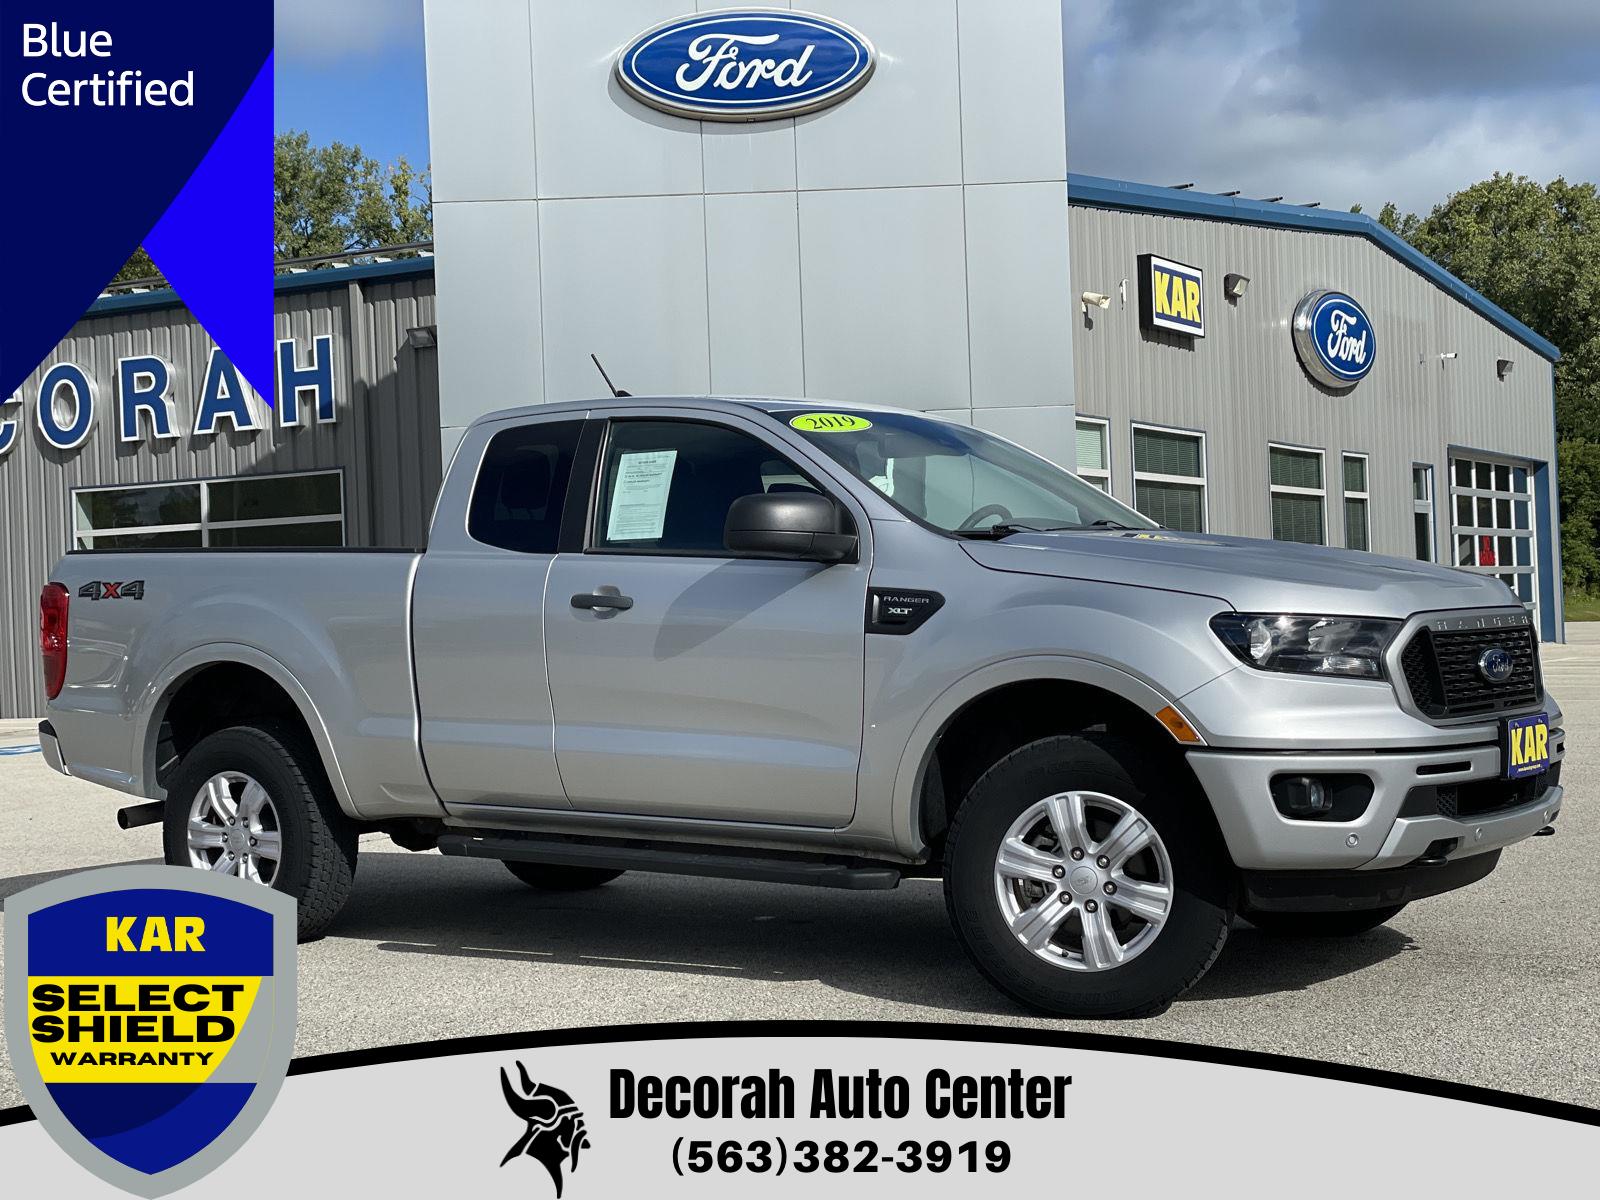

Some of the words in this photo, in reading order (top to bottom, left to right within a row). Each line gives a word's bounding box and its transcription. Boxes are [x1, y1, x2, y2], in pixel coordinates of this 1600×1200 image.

[675, 33, 815, 91] Ford
[1154, 270, 1201, 323] KAR
[1327, 309, 1366, 364] Ford
[806, 416, 856, 429] 2019
[883, 595, 930, 604] RANGER
[888, 607, 913, 615] XLT
[1511, 723, 1549, 766] KAR
